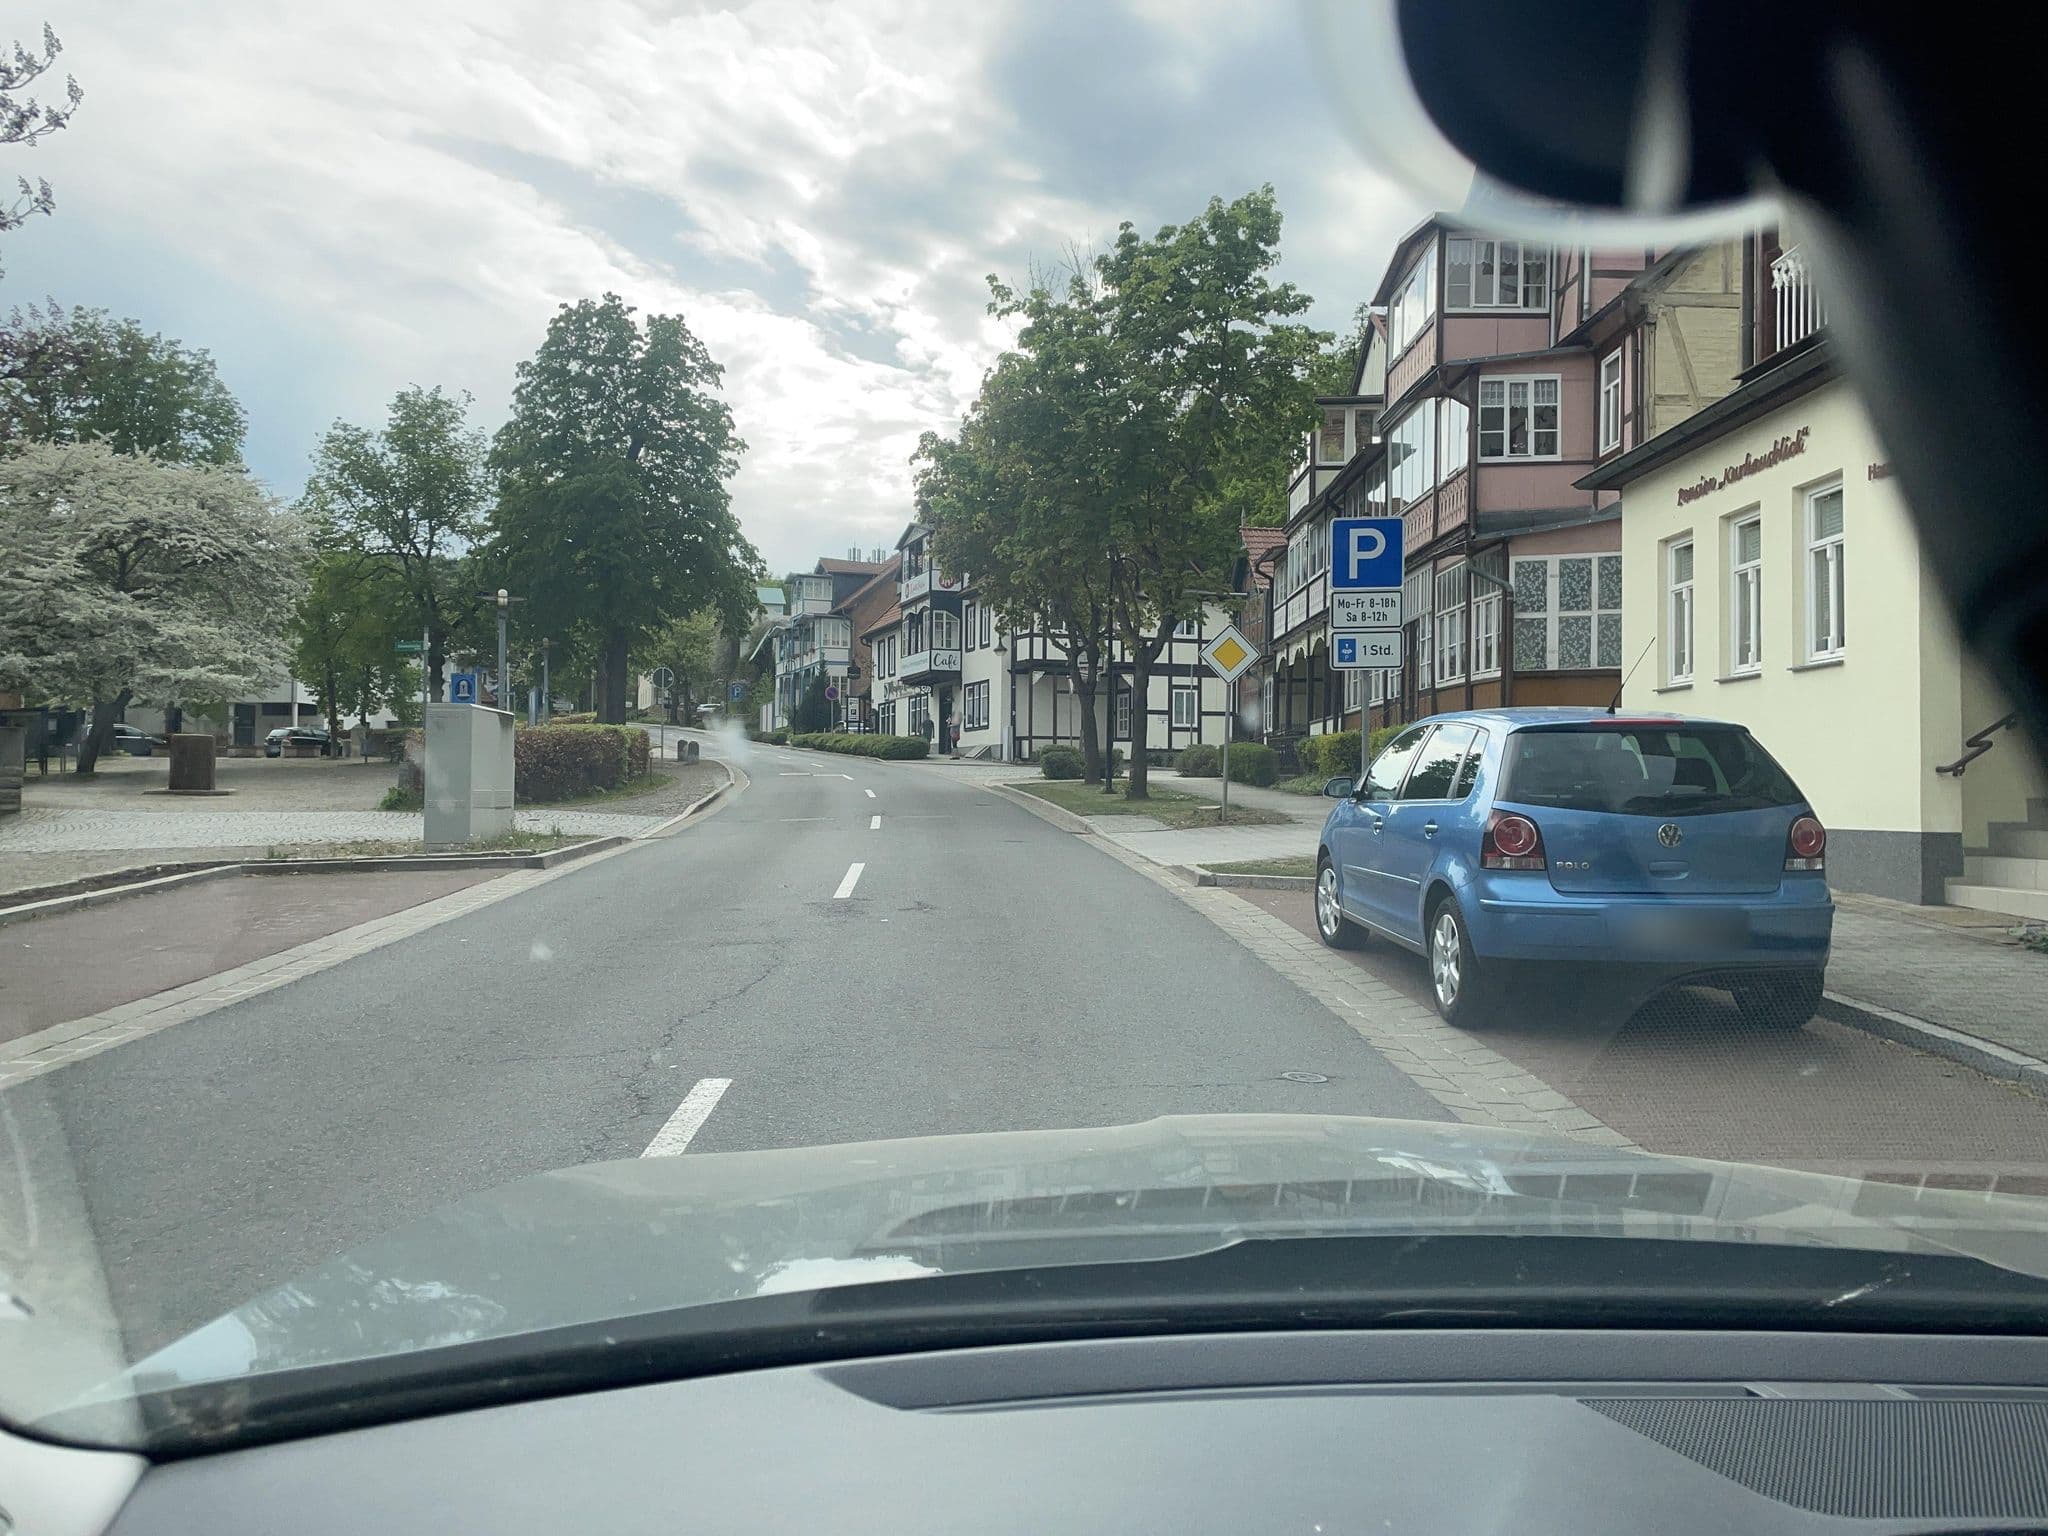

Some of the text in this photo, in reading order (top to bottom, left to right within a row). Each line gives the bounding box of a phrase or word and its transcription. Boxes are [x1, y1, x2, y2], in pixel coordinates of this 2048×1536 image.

[1348, 527, 1386, 580] P
[1337, 597, 1396, 609] Mo-Fr 8-18h
[1346, 611, 1388, 622] Sa 8-12h
[1363, 644, 1394, 656] 1 Std.
[933, 652, 958, 669] Café
[734, 686, 742, 697] P
[1556, 861, 1590, 870] POLO
